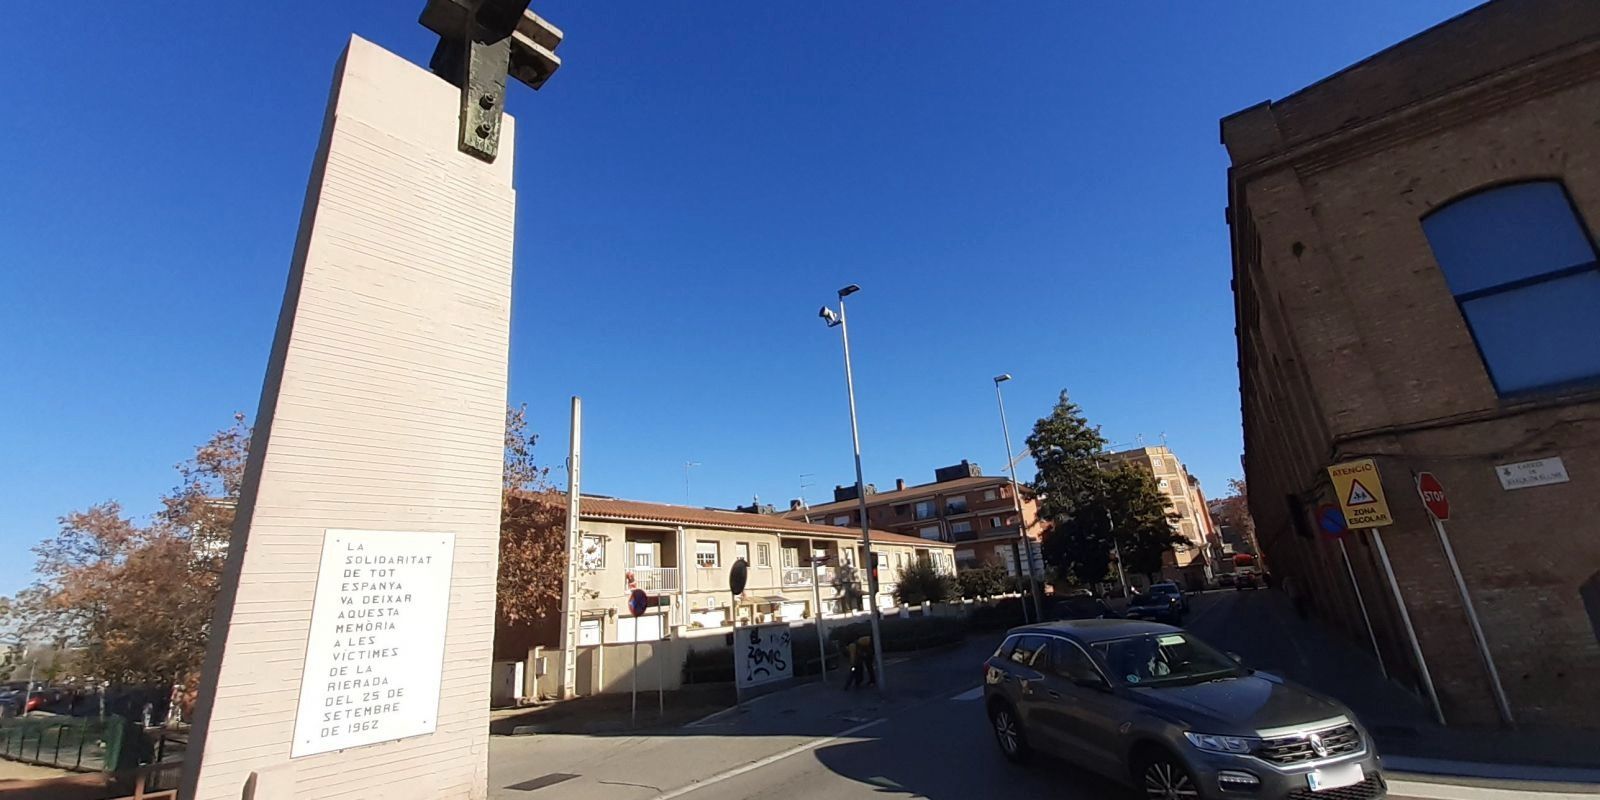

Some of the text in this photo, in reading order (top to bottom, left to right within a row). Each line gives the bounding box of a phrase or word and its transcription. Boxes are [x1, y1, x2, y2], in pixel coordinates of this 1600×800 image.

[1423, 491, 1444, 504] STOP
[1353, 508, 1376, 516] ZONA
[1349, 513, 1387, 525] ESCOLAR
[347, 543, 364, 551] LA
[345, 556, 432, 564] SOLIDARITAT
[344, 569, 396, 578] DE TOT
[341, 582, 403, 591] ESPANYA
[340, 594, 412, 605] VA DEIXAR
[337, 608, 400, 619] AQUESTA
[335, 620, 396, 633] MEMÒRIA
[334, 636, 376, 648] A LES
[333, 648, 399, 661] VÍCTIMES
[329, 665, 373, 677] DE LA
[327, 677, 389, 692] RIERADA
[325, 688, 405, 707] DEL 25 DE
[323, 702, 401, 722] SETEMBRE
[321, 720, 379, 738] DE 1962
